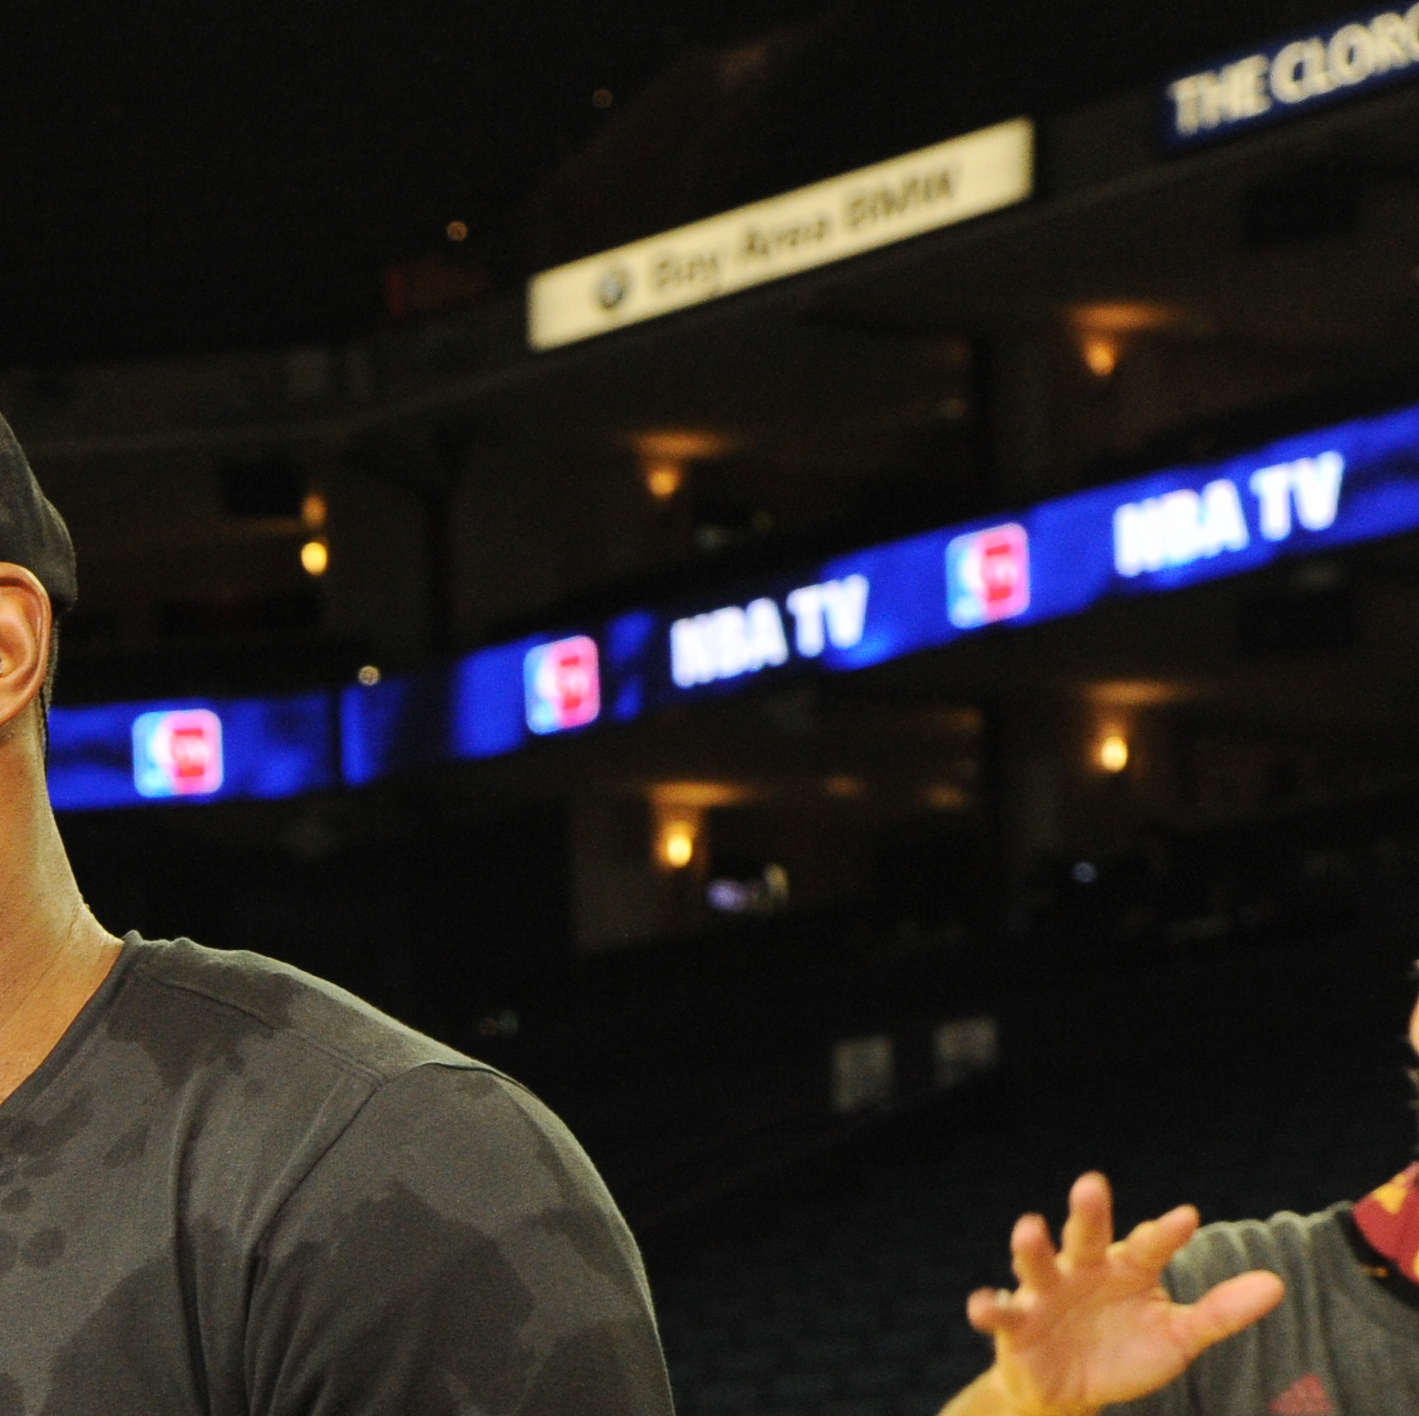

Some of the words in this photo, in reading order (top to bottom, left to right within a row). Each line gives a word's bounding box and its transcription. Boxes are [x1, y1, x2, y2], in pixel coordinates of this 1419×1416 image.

[1167, 54, 1272, 137] THE
[742, 215, 828, 258] Area
[1114, 478, 1250, 577] NBA
[1250, 450, 1345, 541] TV
[670, 597, 789, 689] NBA
[786, 573, 870, 658] TV
